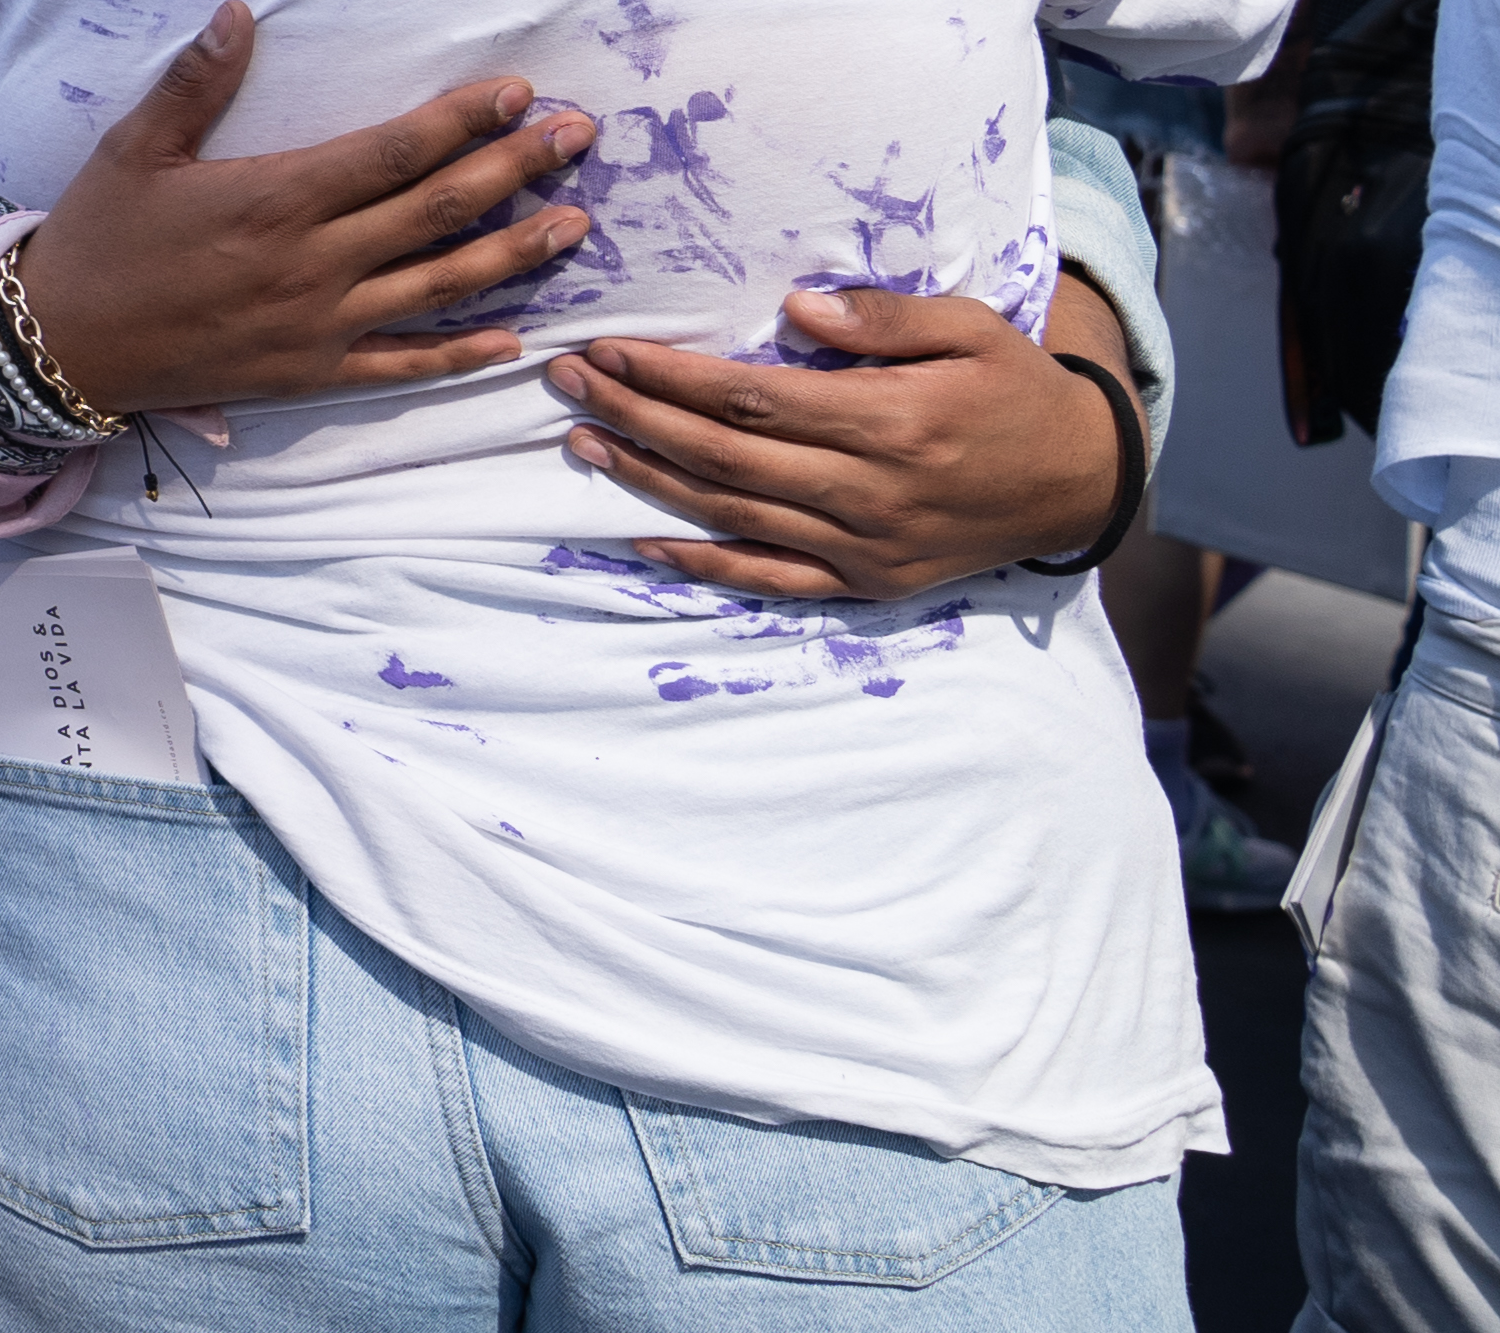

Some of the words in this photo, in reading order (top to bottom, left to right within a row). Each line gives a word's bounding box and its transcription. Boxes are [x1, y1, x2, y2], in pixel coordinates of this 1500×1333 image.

[32, 622, 48, 637] &
[45, 605, 73, 666] VIDA
[39, 650, 68, 709] DIOS
[66, 679, 86, 710] LA
